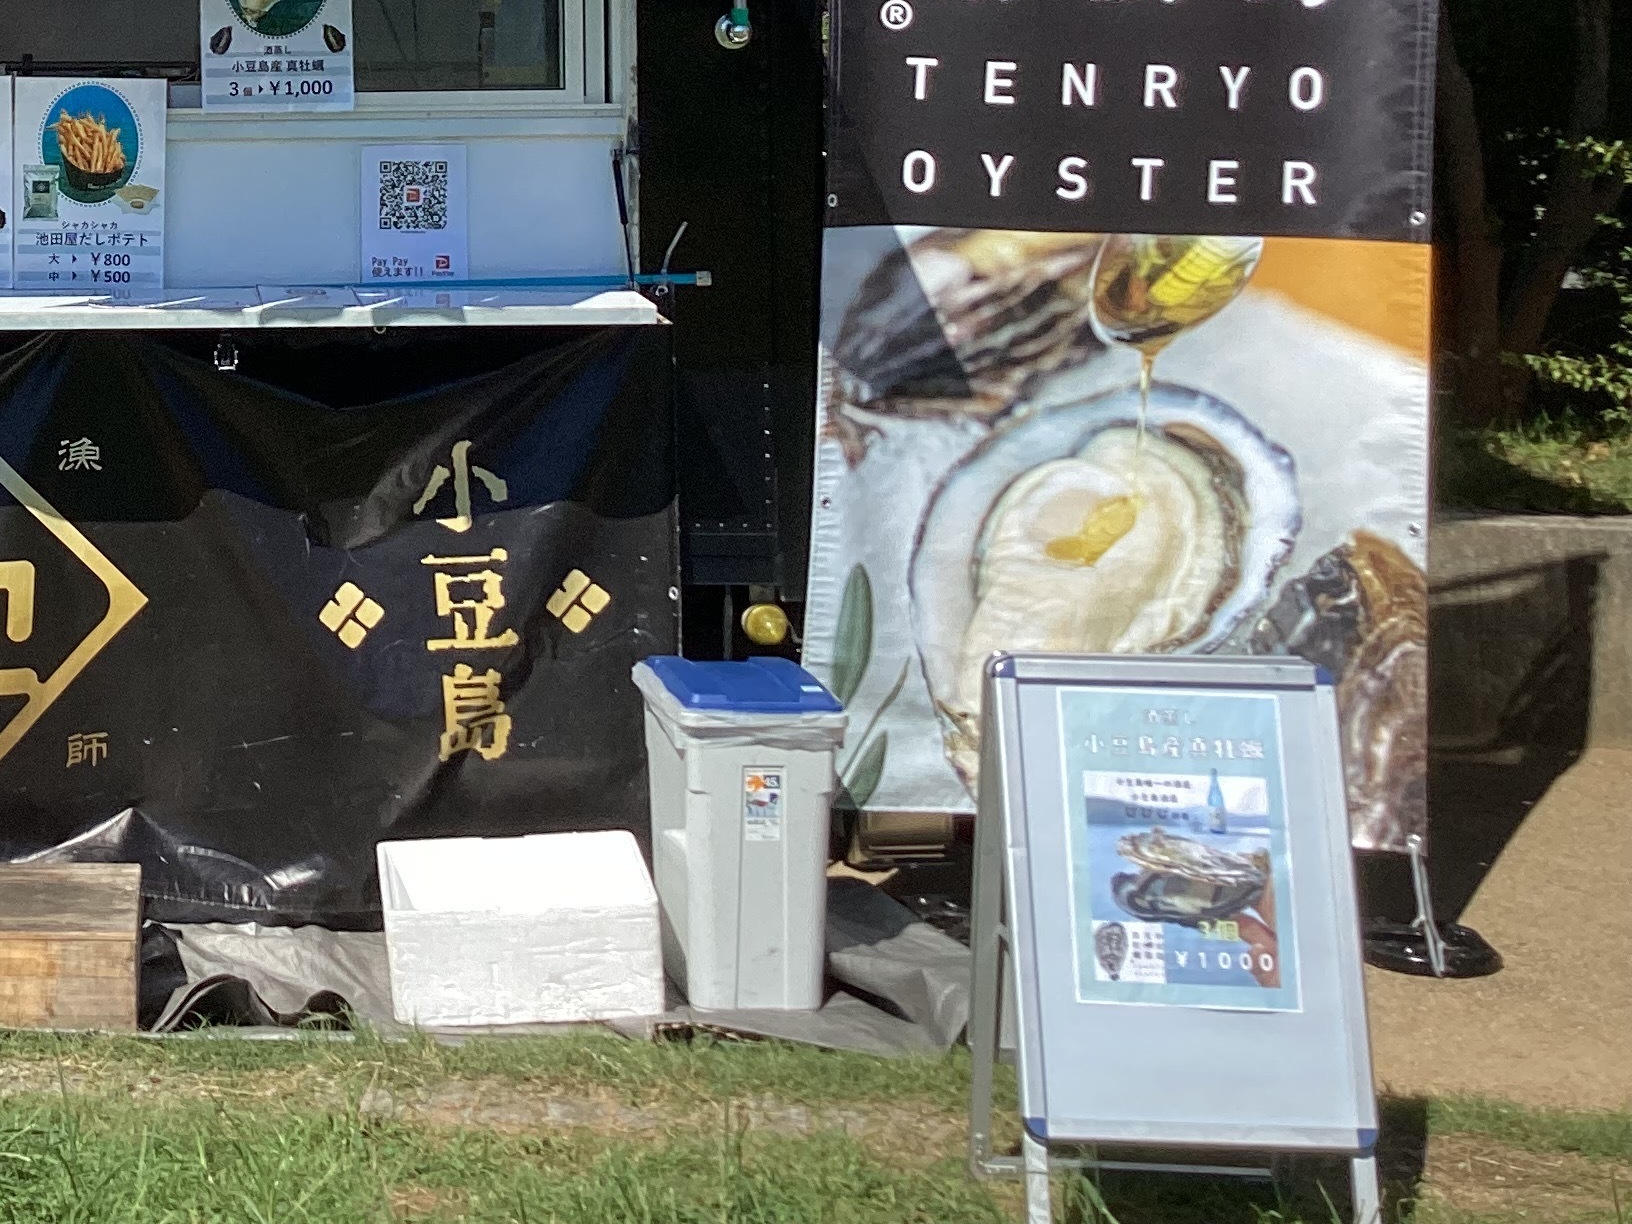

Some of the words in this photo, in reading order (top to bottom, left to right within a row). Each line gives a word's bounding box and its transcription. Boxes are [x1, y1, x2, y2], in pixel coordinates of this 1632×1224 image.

[232, 60, 283, 73] 小豆島産
[905, 56, 1325, 112] TENRYO
[902, 149, 1319, 206] OYSTER
[61, 221, 118, 230] シャカシャカ
[35, 232, 148, 247] 池田屋だしポテト
[48, 253, 60, 265] 大
[90, 252, 131, 266] ¥800
[372, 256, 387, 267] Pay
[392, 256, 408, 267] Pay
[48, 271, 60, 282] 中
[90, 269, 131, 283] ¥500
[413, 439, 520, 763] 小豆島
